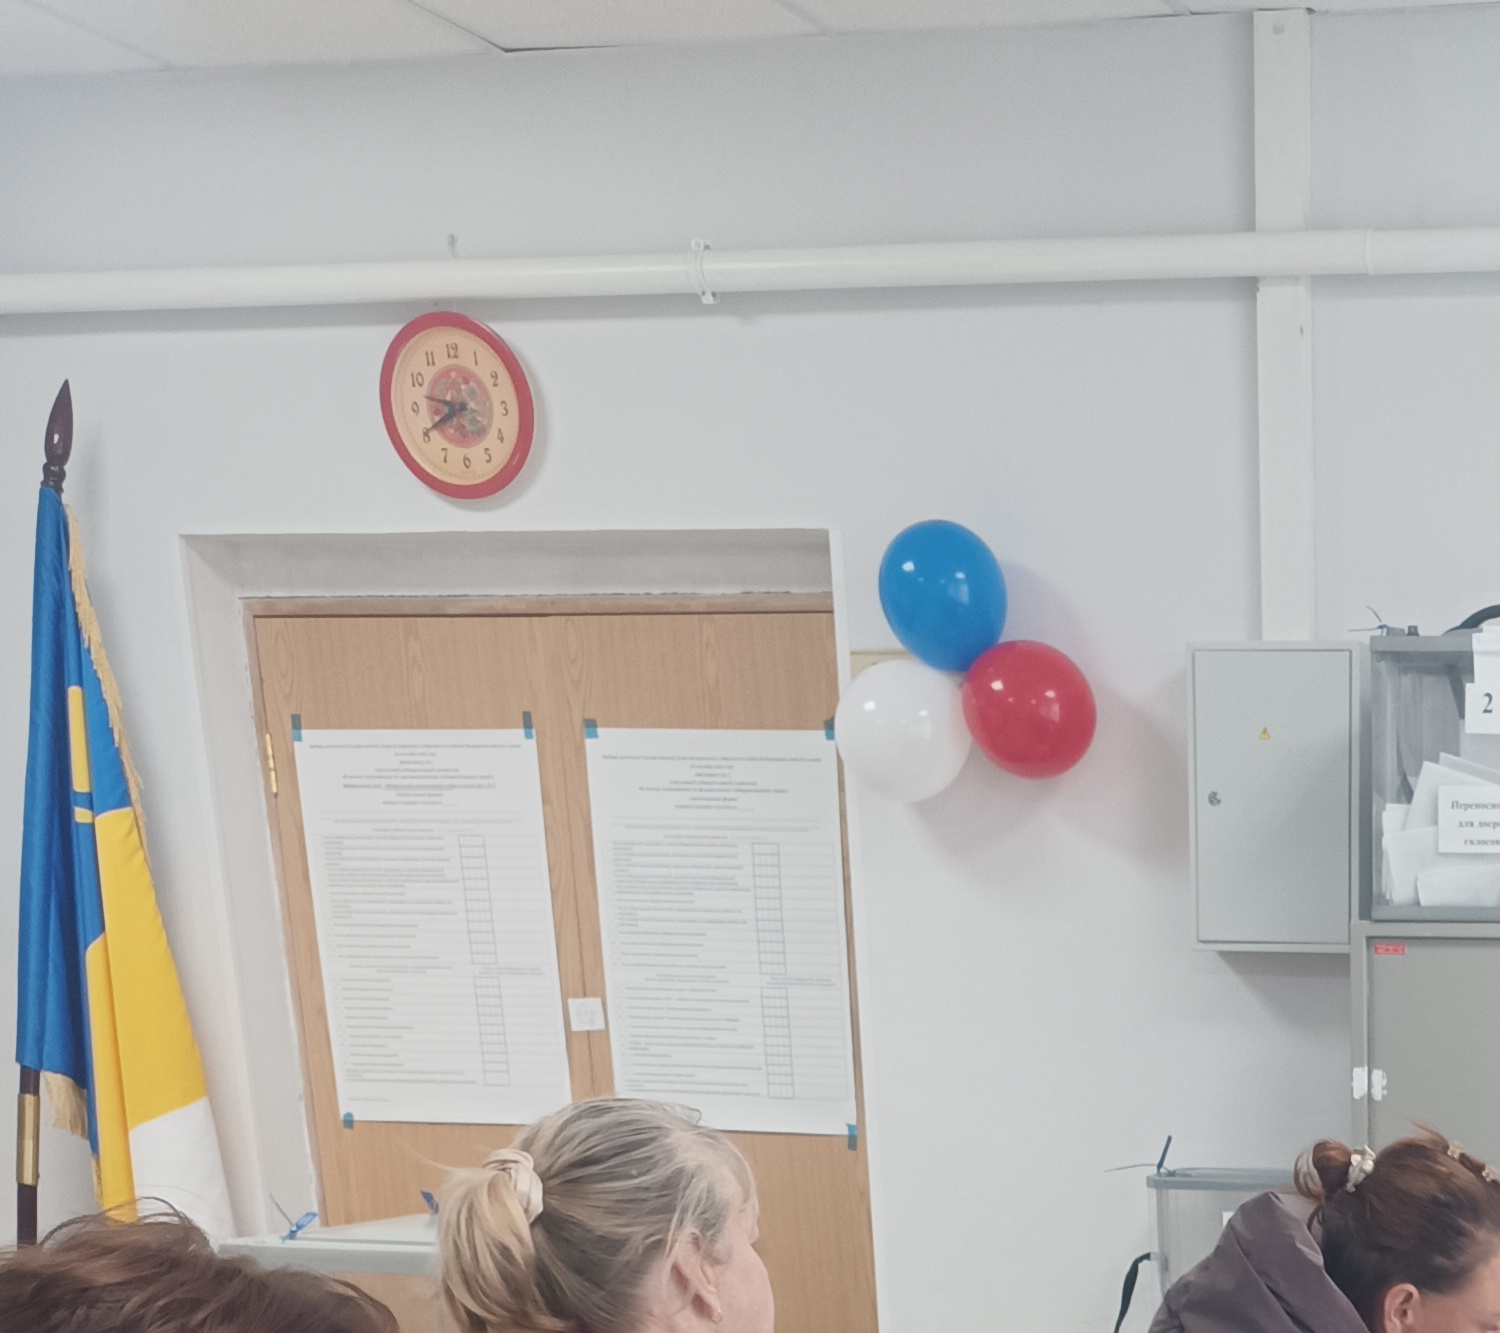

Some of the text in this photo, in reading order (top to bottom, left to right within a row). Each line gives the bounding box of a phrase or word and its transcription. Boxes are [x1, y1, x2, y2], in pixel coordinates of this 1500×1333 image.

[425, 350, 435, 366] 11
[446, 343, 459, 359] 12
[473, 350, 478, 366] 1
[410, 372, 424, 388] 10
[490, 371, 499, 387] 2
[411, 401, 419, 417] 9
[500, 400, 508, 416] 3
[496, 428, 505, 443] 4
[441, 447, 448, 464] 7
[463, 454, 471, 469] 6
[483, 448, 492, 463] 5
[1482, 692, 1493, 714] 2
